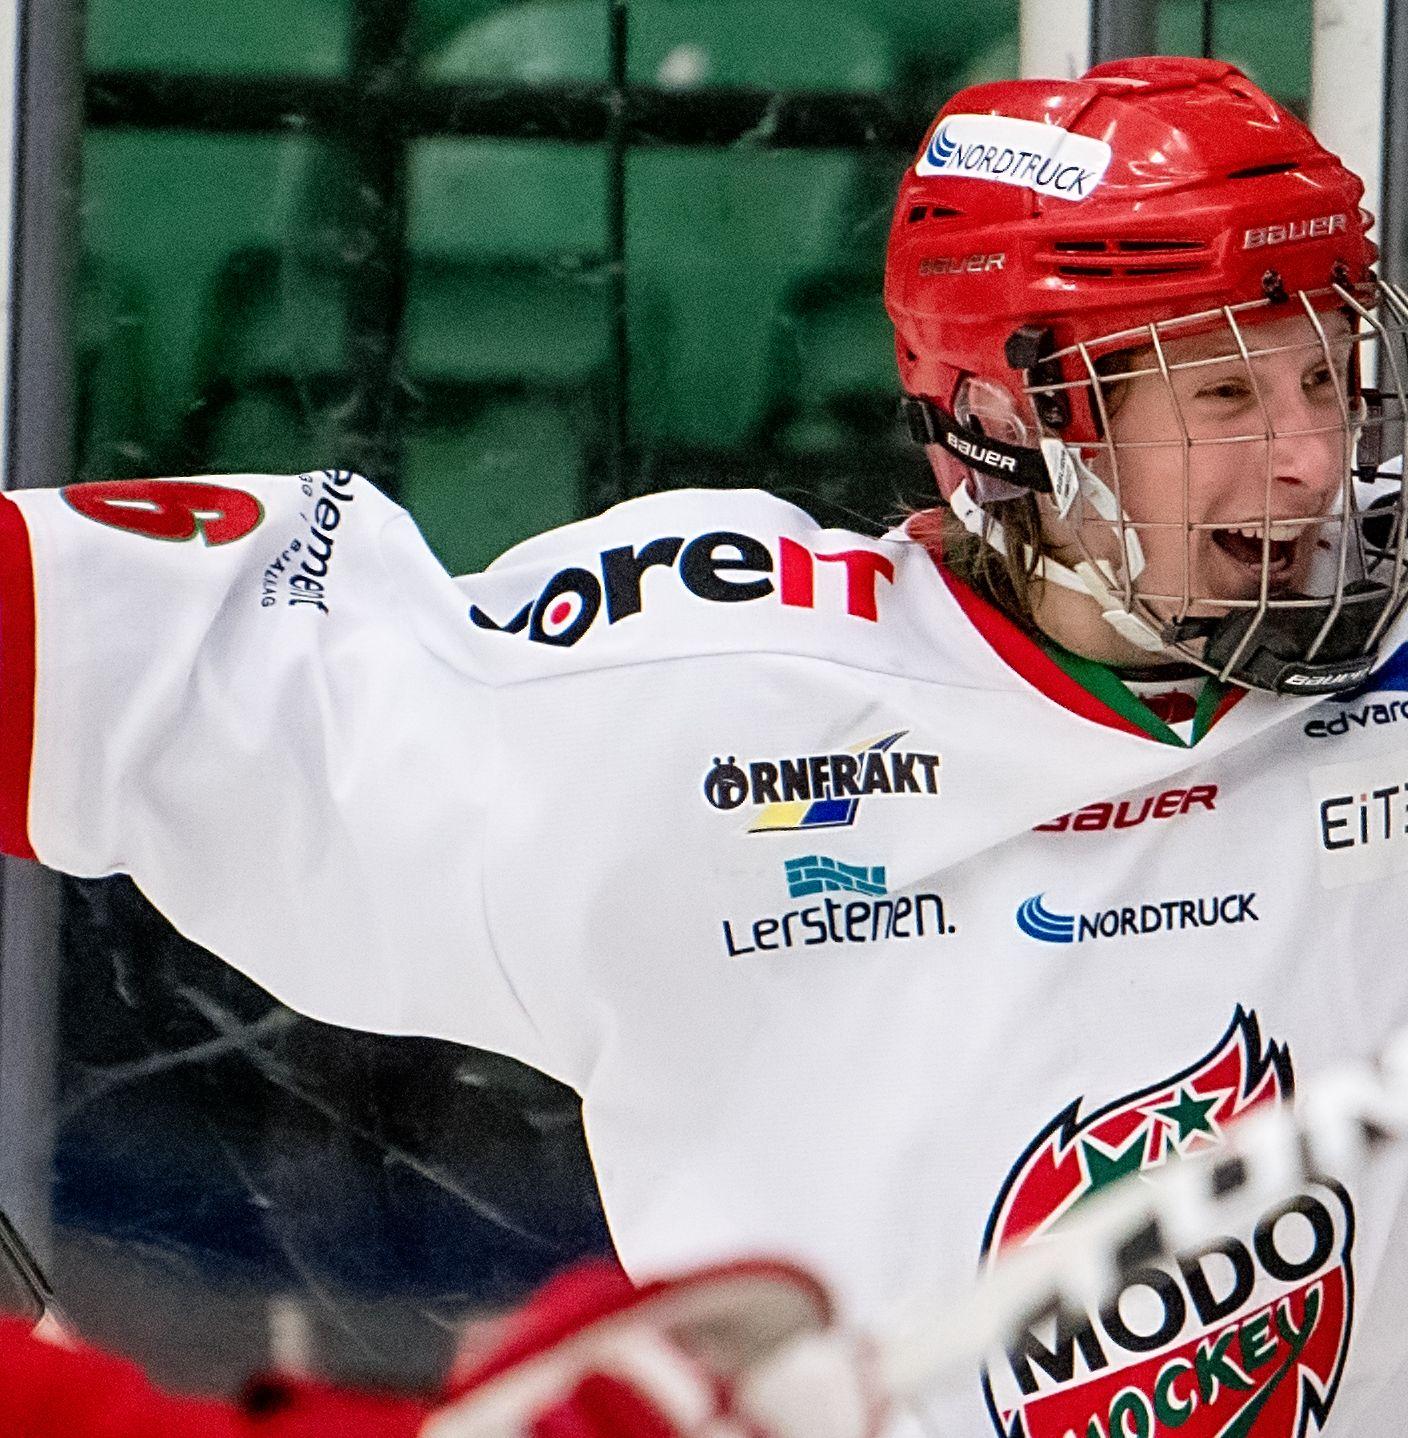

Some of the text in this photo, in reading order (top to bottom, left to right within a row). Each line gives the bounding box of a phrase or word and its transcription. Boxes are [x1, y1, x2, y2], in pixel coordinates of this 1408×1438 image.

[948, 143, 1096, 195] NORDTRUCK
[1242, 213, 1348, 250] BAUER
[919, 252, 1006, 278] BAUER
[947, 432, 1017, 473] BAUER
[704, 752, 940, 810] ÖRNFRAKT
[1078, 892, 1260, 943] NORDTRUCK
[1007, 1195, 1335, 1396] MODO
